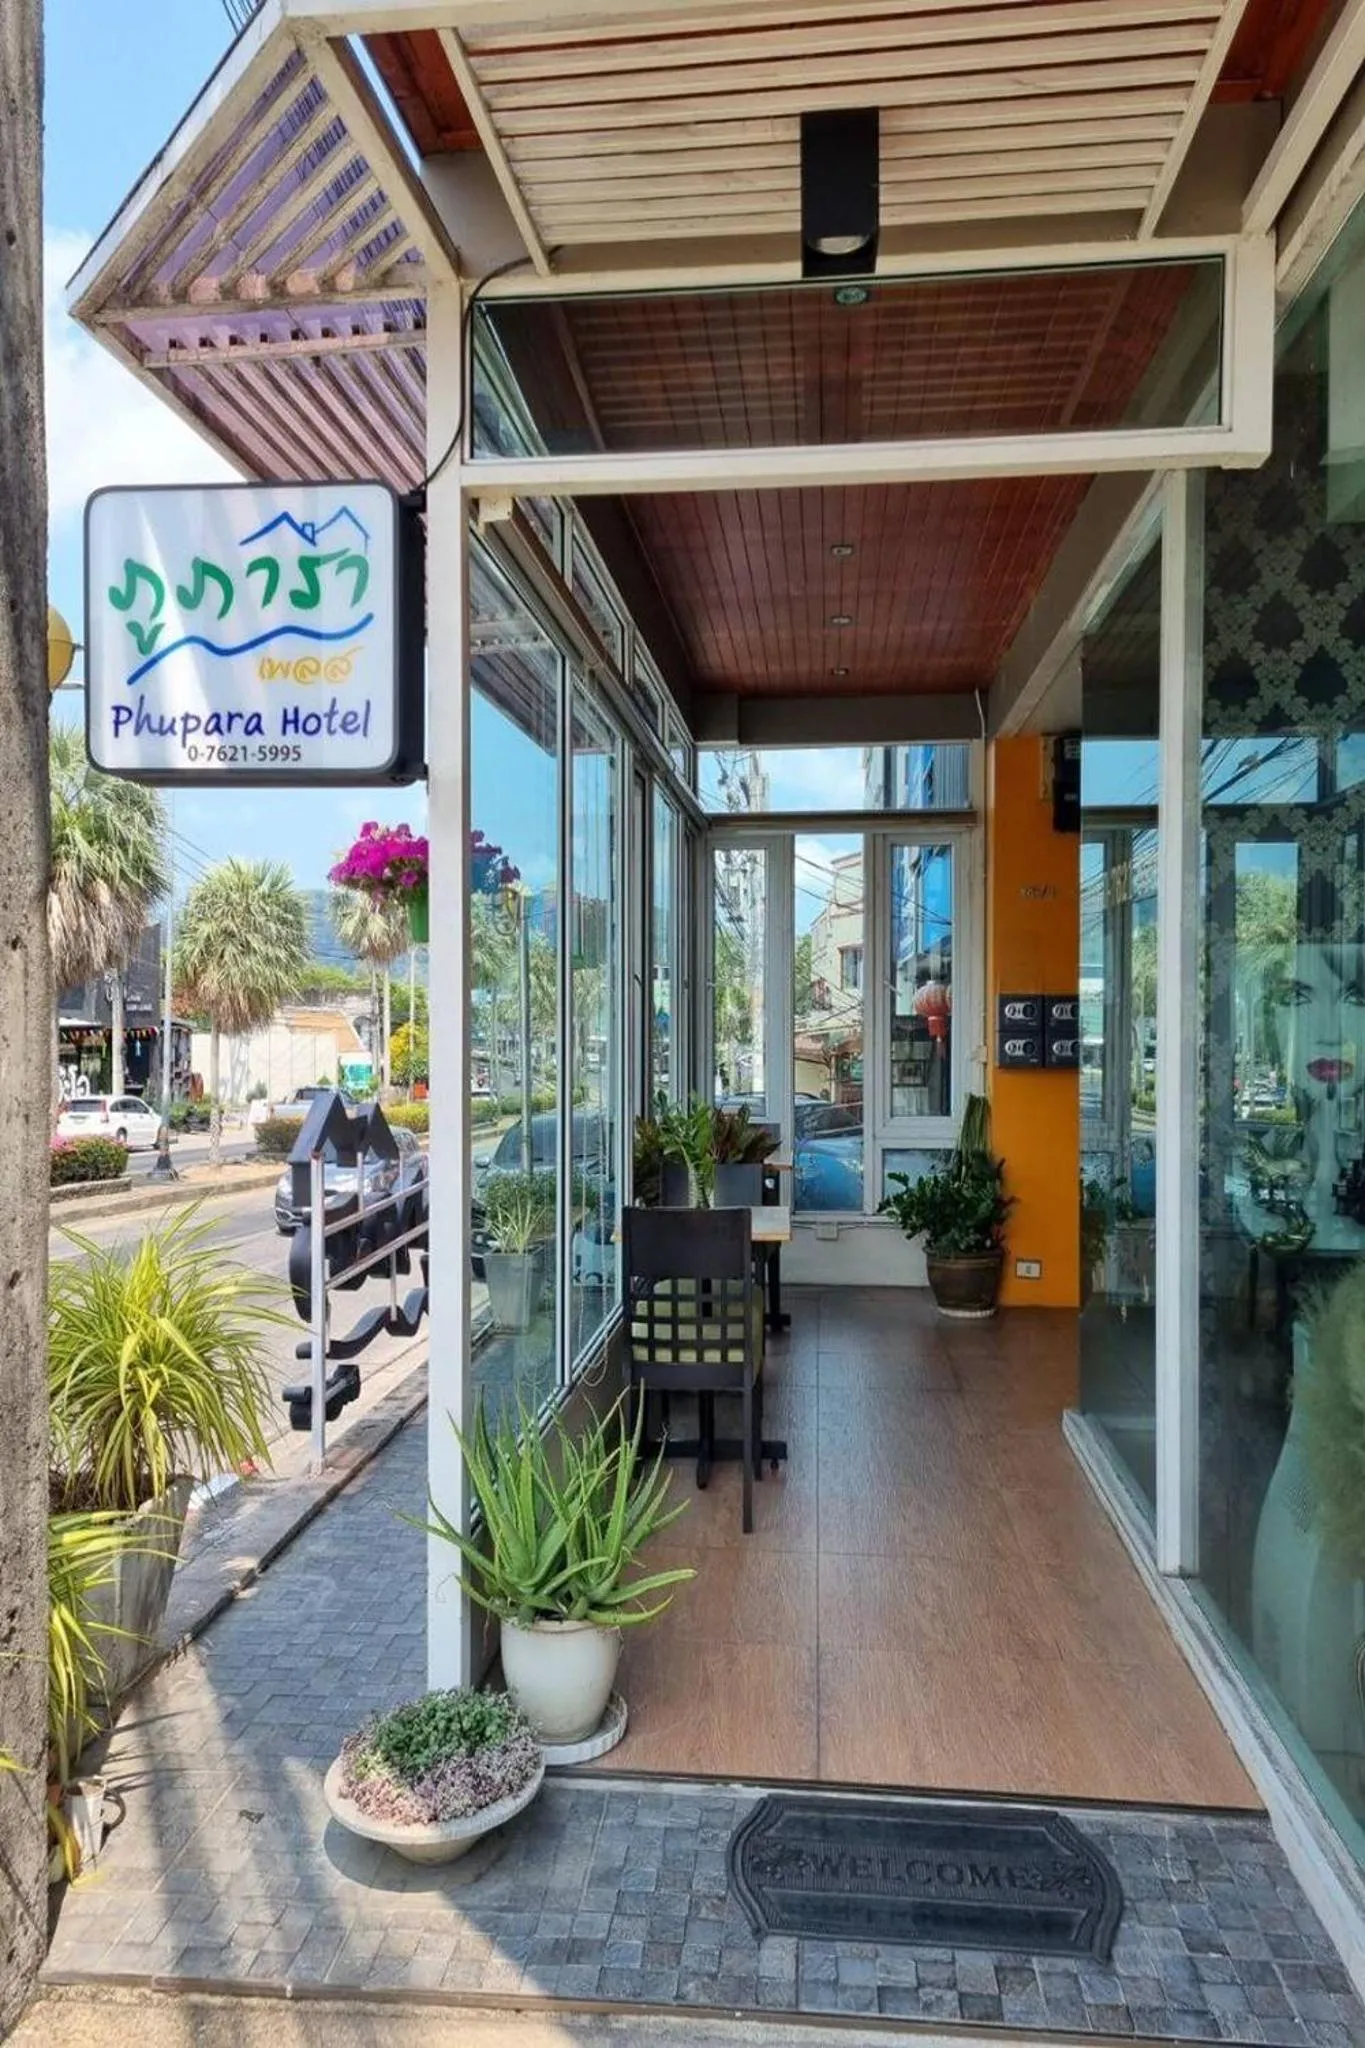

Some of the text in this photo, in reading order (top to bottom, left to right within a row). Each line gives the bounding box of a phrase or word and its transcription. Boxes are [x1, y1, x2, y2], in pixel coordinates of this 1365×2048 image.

[109, 548, 370, 656] ภูภารา
[111, 695, 371, 747] Phupara Hotel
[188, 746, 302, 762] 0-7621-5995
[809, 1853, 1031, 1889] WELCOME
